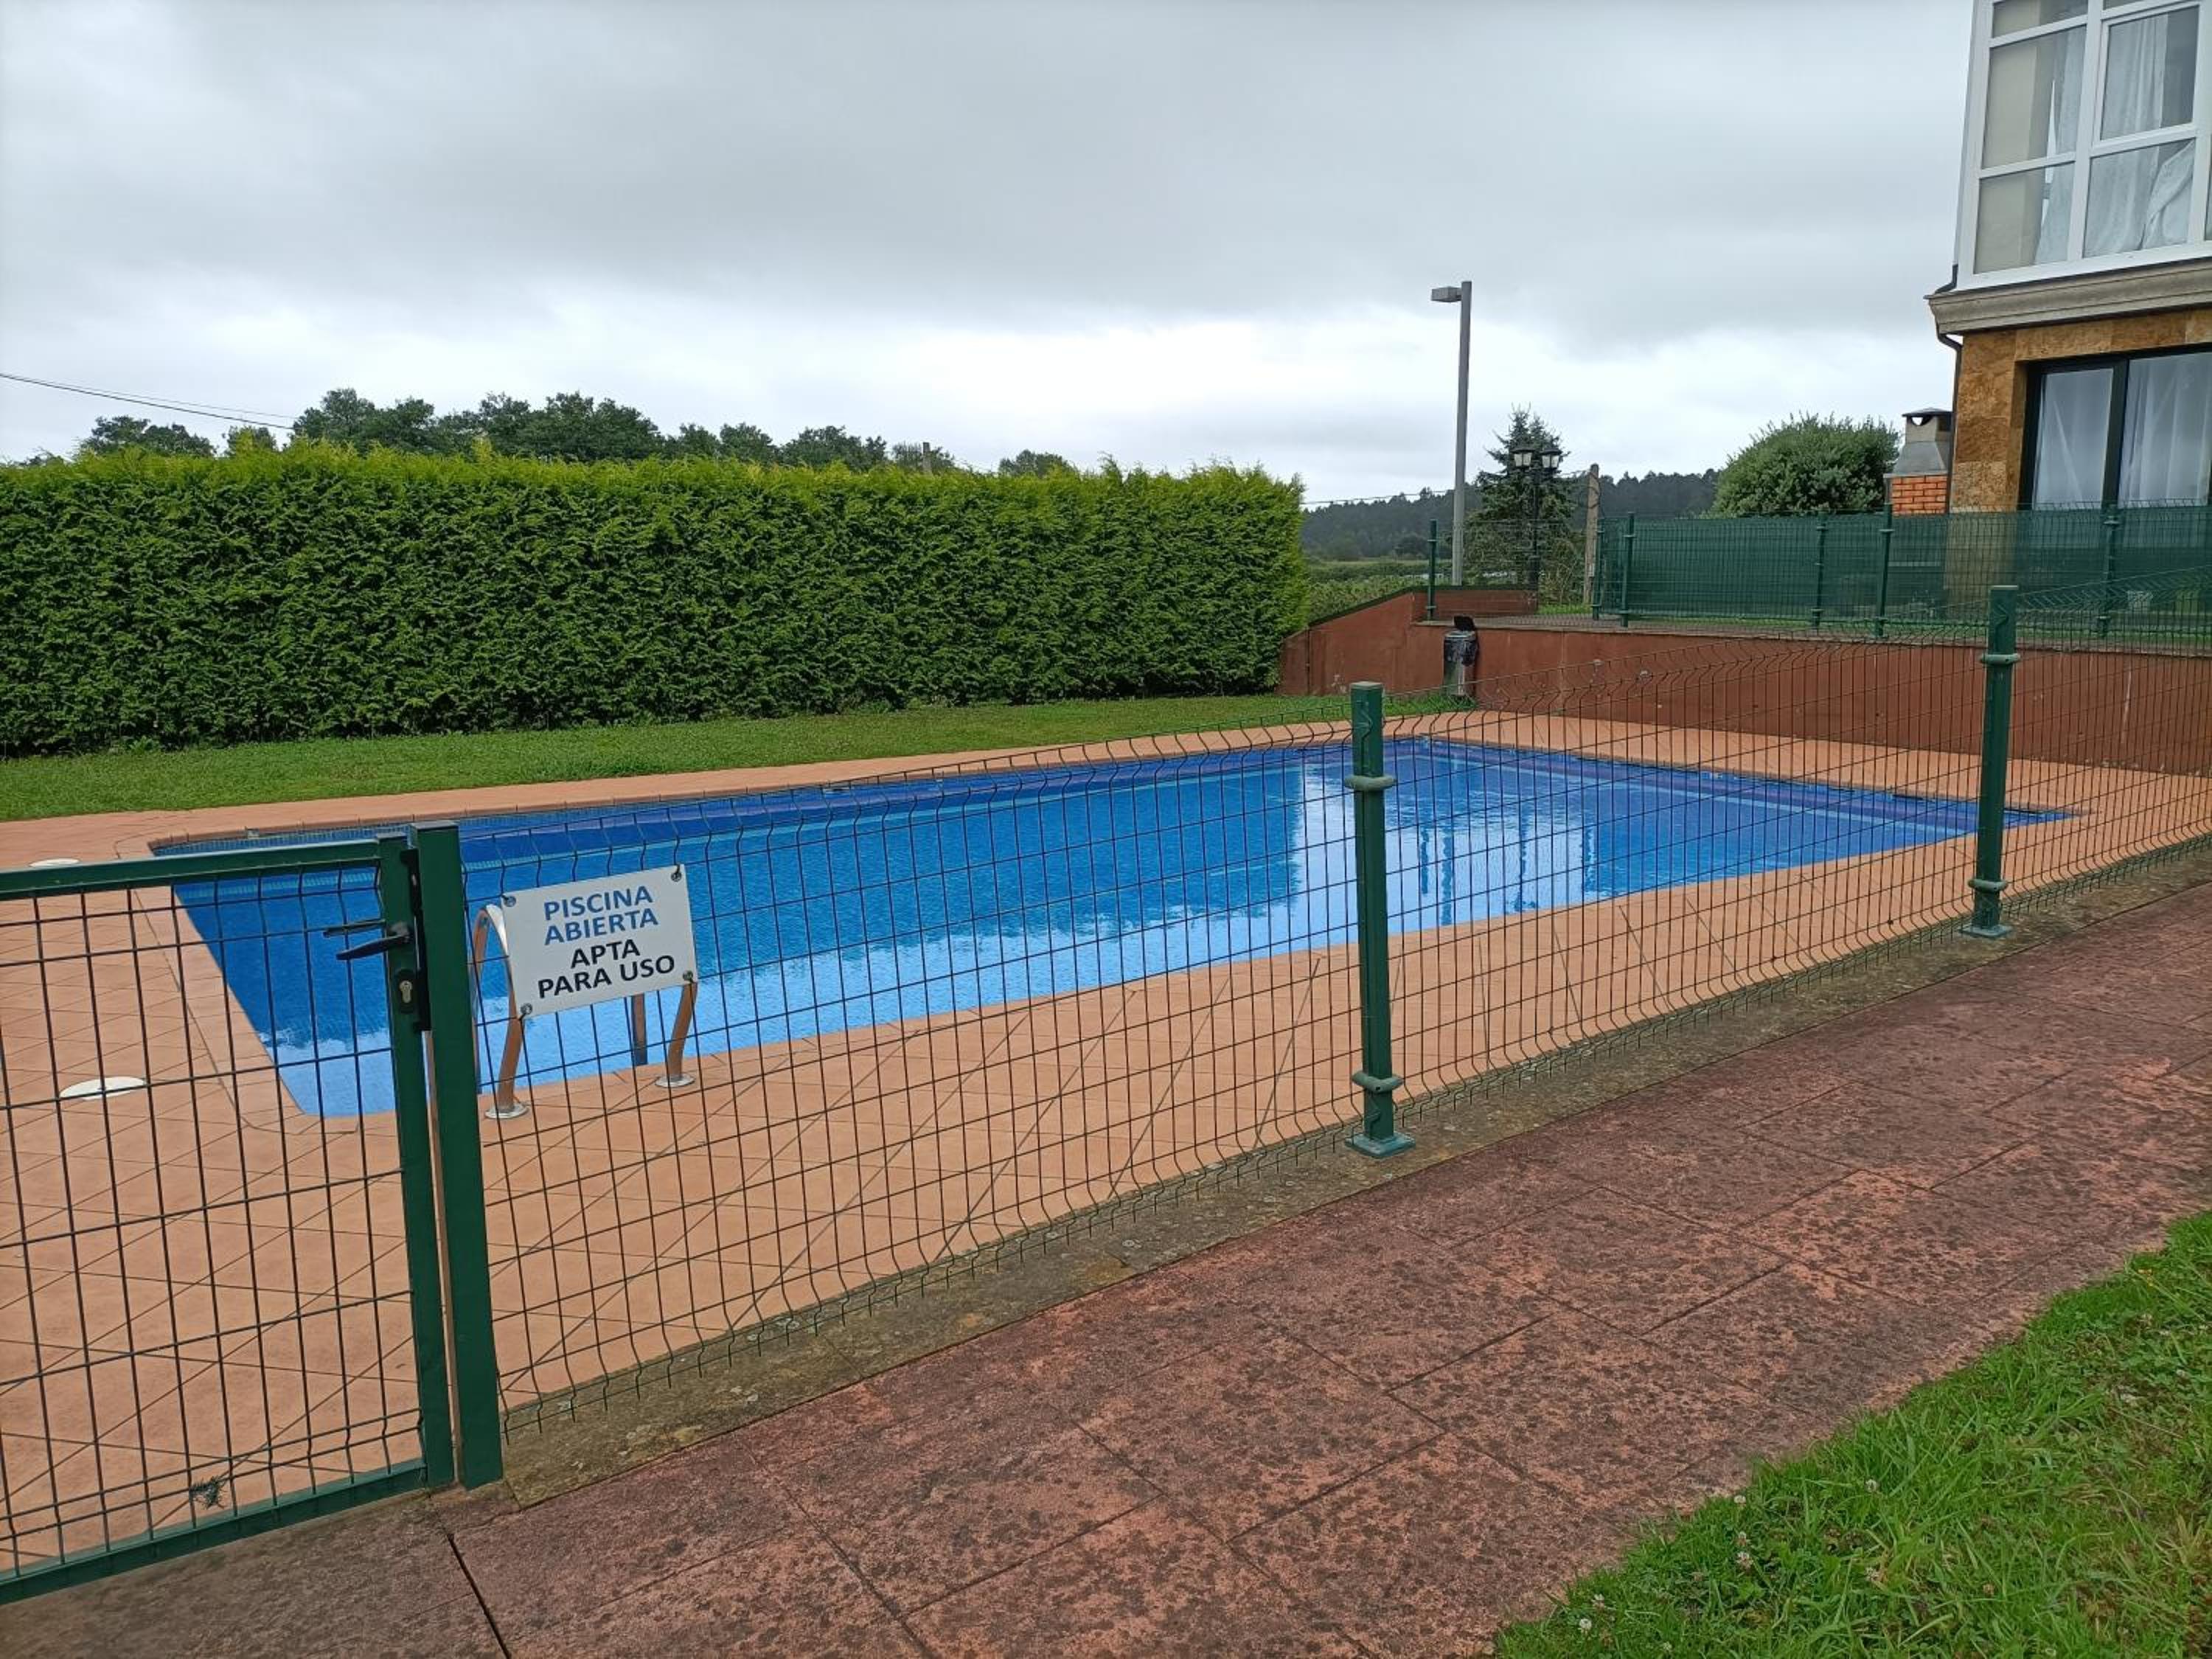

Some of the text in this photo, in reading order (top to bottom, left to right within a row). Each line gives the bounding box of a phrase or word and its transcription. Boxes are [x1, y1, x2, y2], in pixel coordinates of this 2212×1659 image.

[543, 886, 653, 921] PISCINA
[544, 908, 658, 946] ABIERTA
[571, 939, 641, 970] APTA
[538, 955, 675, 998] PARA USO
